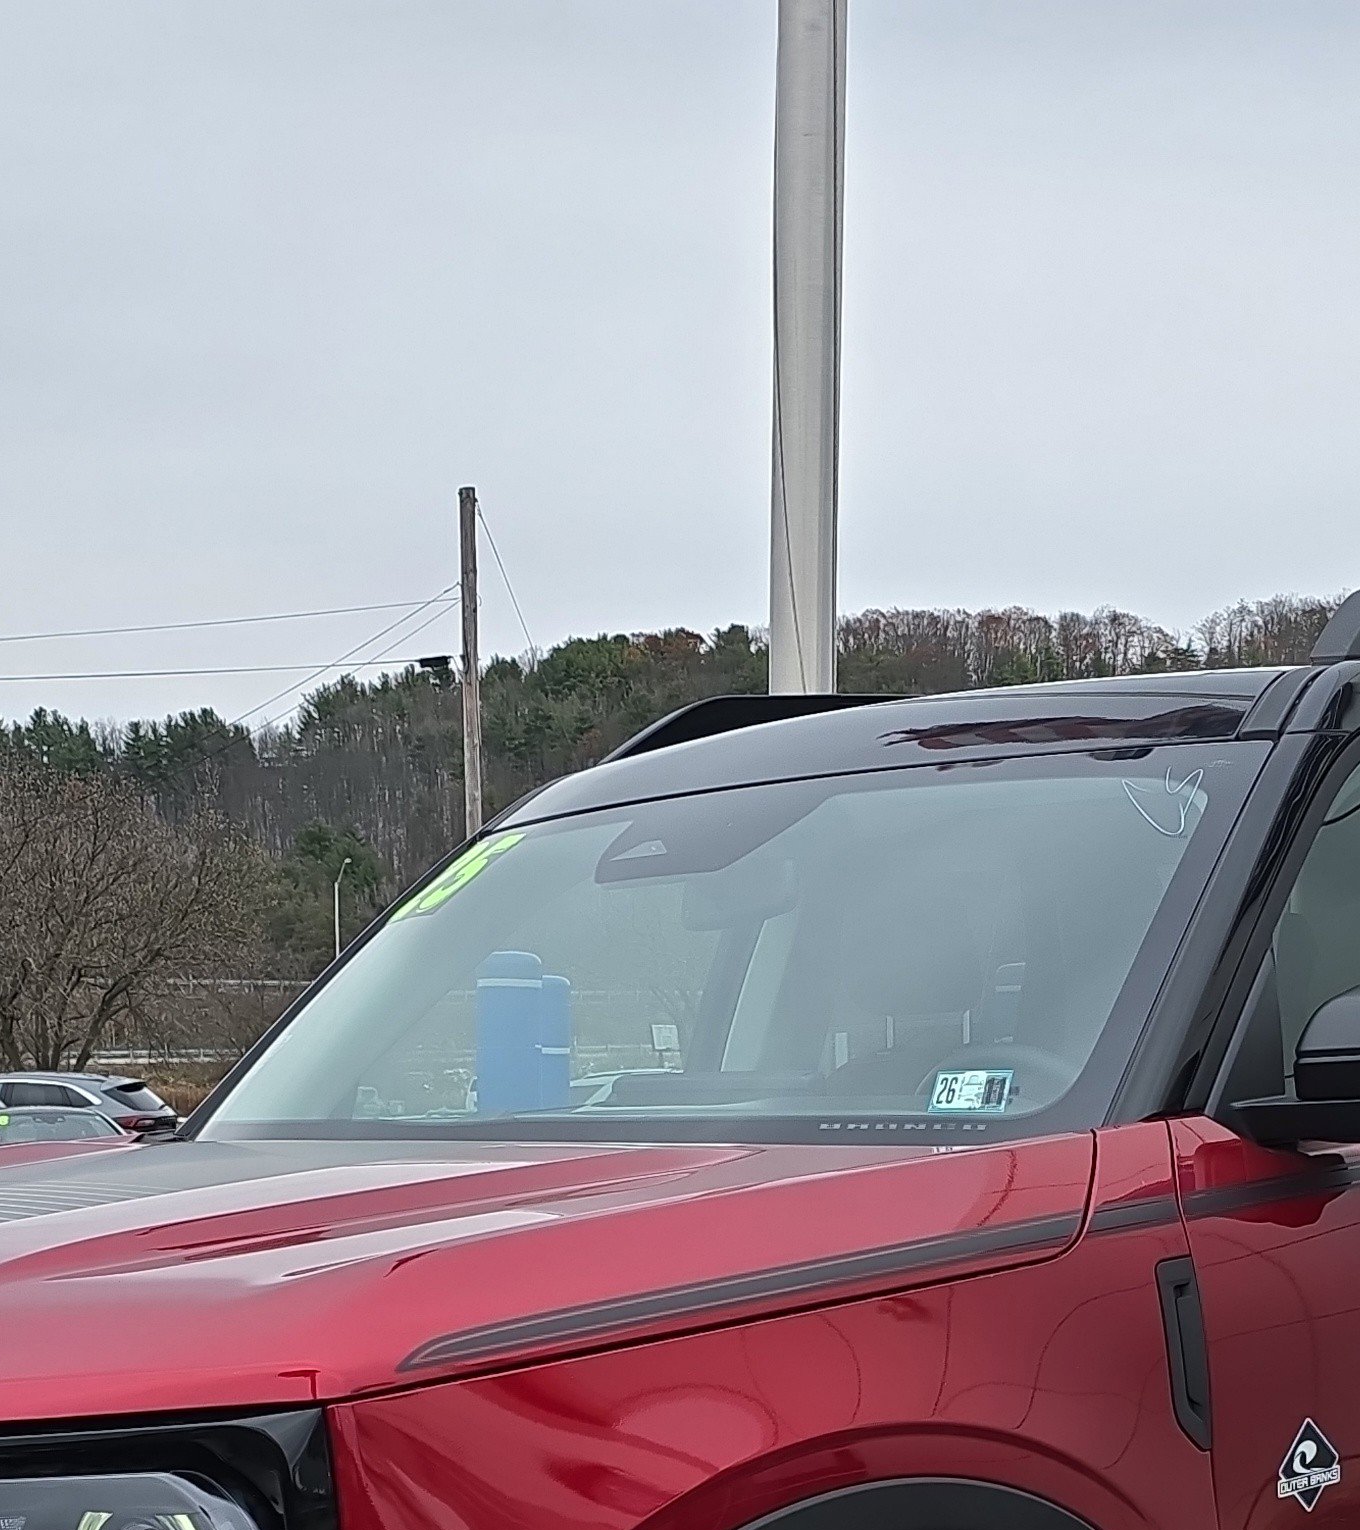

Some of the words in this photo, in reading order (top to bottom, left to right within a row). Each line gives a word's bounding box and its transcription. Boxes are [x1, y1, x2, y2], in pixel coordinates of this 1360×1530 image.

[935, 1076, 959, 1105] 26
[818, 1122, 987, 1131] BRONCO
[1280, 1477, 1309, 1493] OUTER
[1309, 1468, 1339, 1486] BANKS
